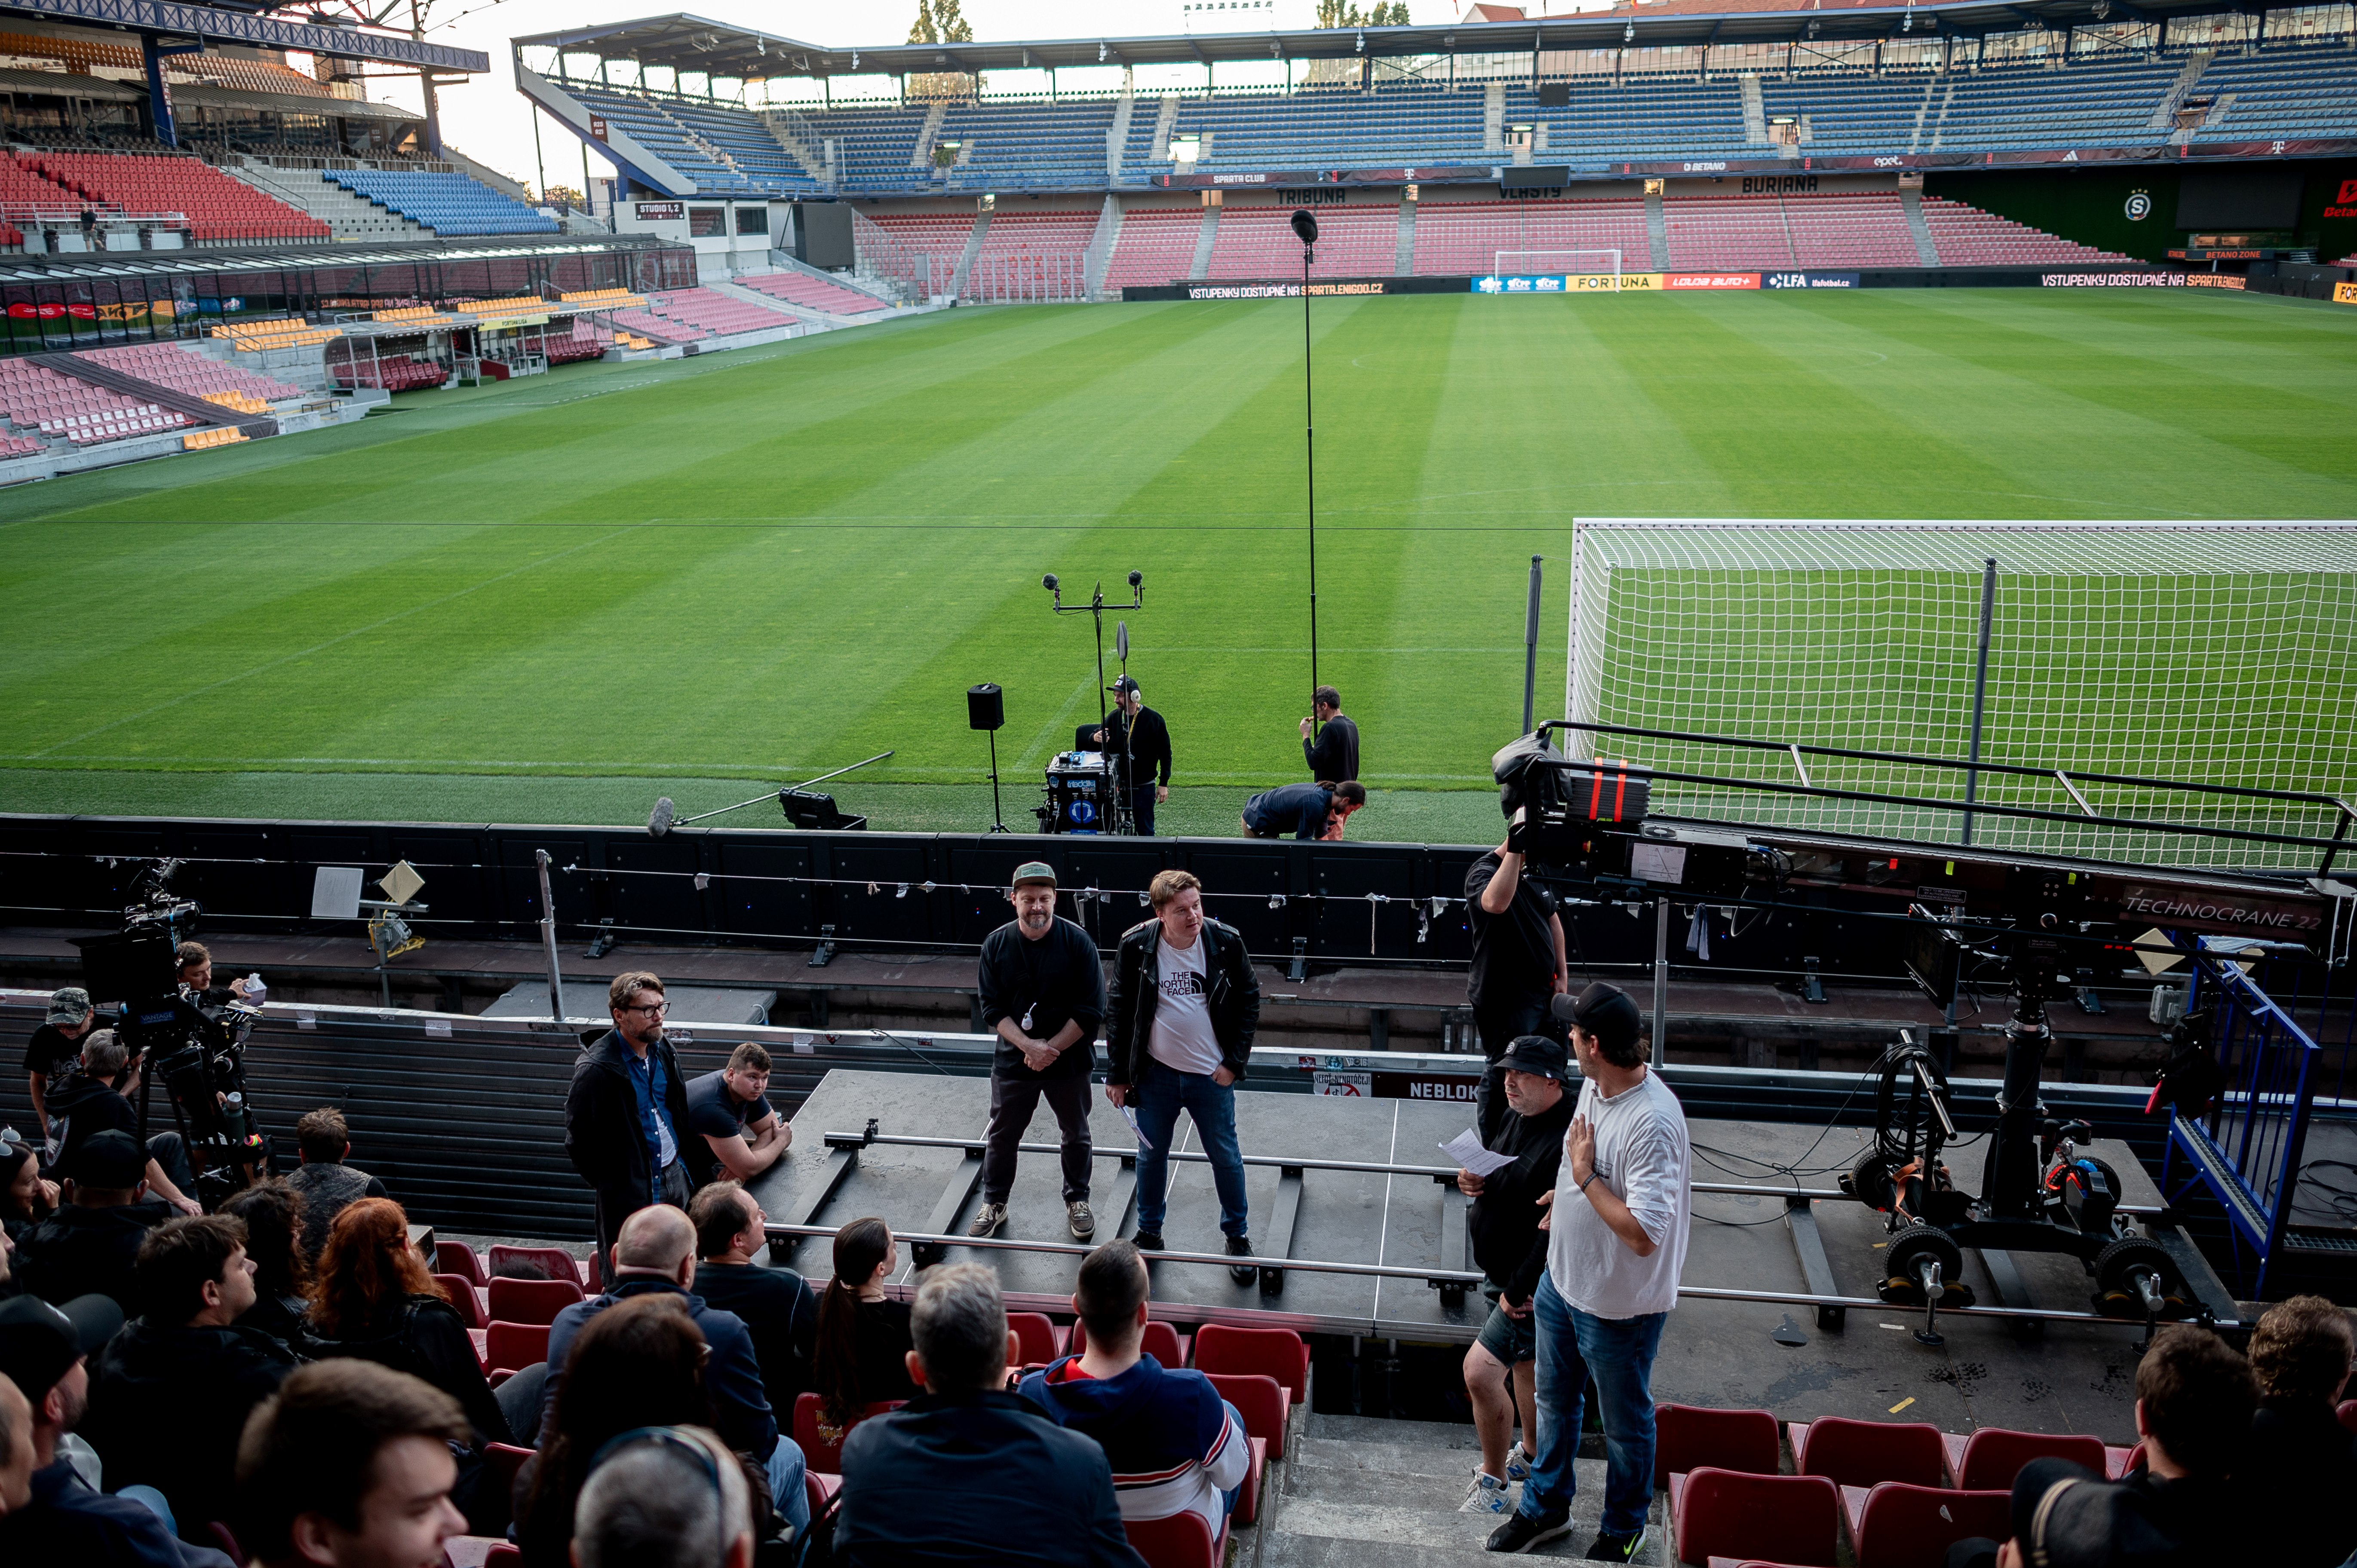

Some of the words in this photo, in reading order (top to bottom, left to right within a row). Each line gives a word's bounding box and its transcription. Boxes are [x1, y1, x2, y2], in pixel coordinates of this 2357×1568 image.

[1692, 162, 1726, 171] BETANO
[1213, 175, 1244, 184] SPARTA
[1245, 174, 1265, 182] CLUB
[1742, 175, 1818, 193] BURIANA
[1276, 188, 1345, 205] TRIBUNA
[640, 204, 666, 212] STUDIO
[1578, 277, 1650, 288] FORTUNA
[1783, 274, 1807, 287] LFA
[2042, 274, 2107, 286] VSTUPENKY
[2108, 271, 2167, 286] DOSTUPNÉ
[2168, 274, 2185, 286] NA
[1188, 287, 1239, 298] VSTUPENKY
[1241, 284, 1286, 298] DOSTUPNÉ
[1287, 286, 1299, 296] NA
[2126, 897, 2293, 927] TECHNOCRANE
[2294, 916, 2322, 930] 22
[1171, 971, 1190, 980] THE
[1158, 979, 1190, 988] NORTH
[1167, 987, 1191, 996] FACE
[141, 1012, 173, 1021] VANTAGE
